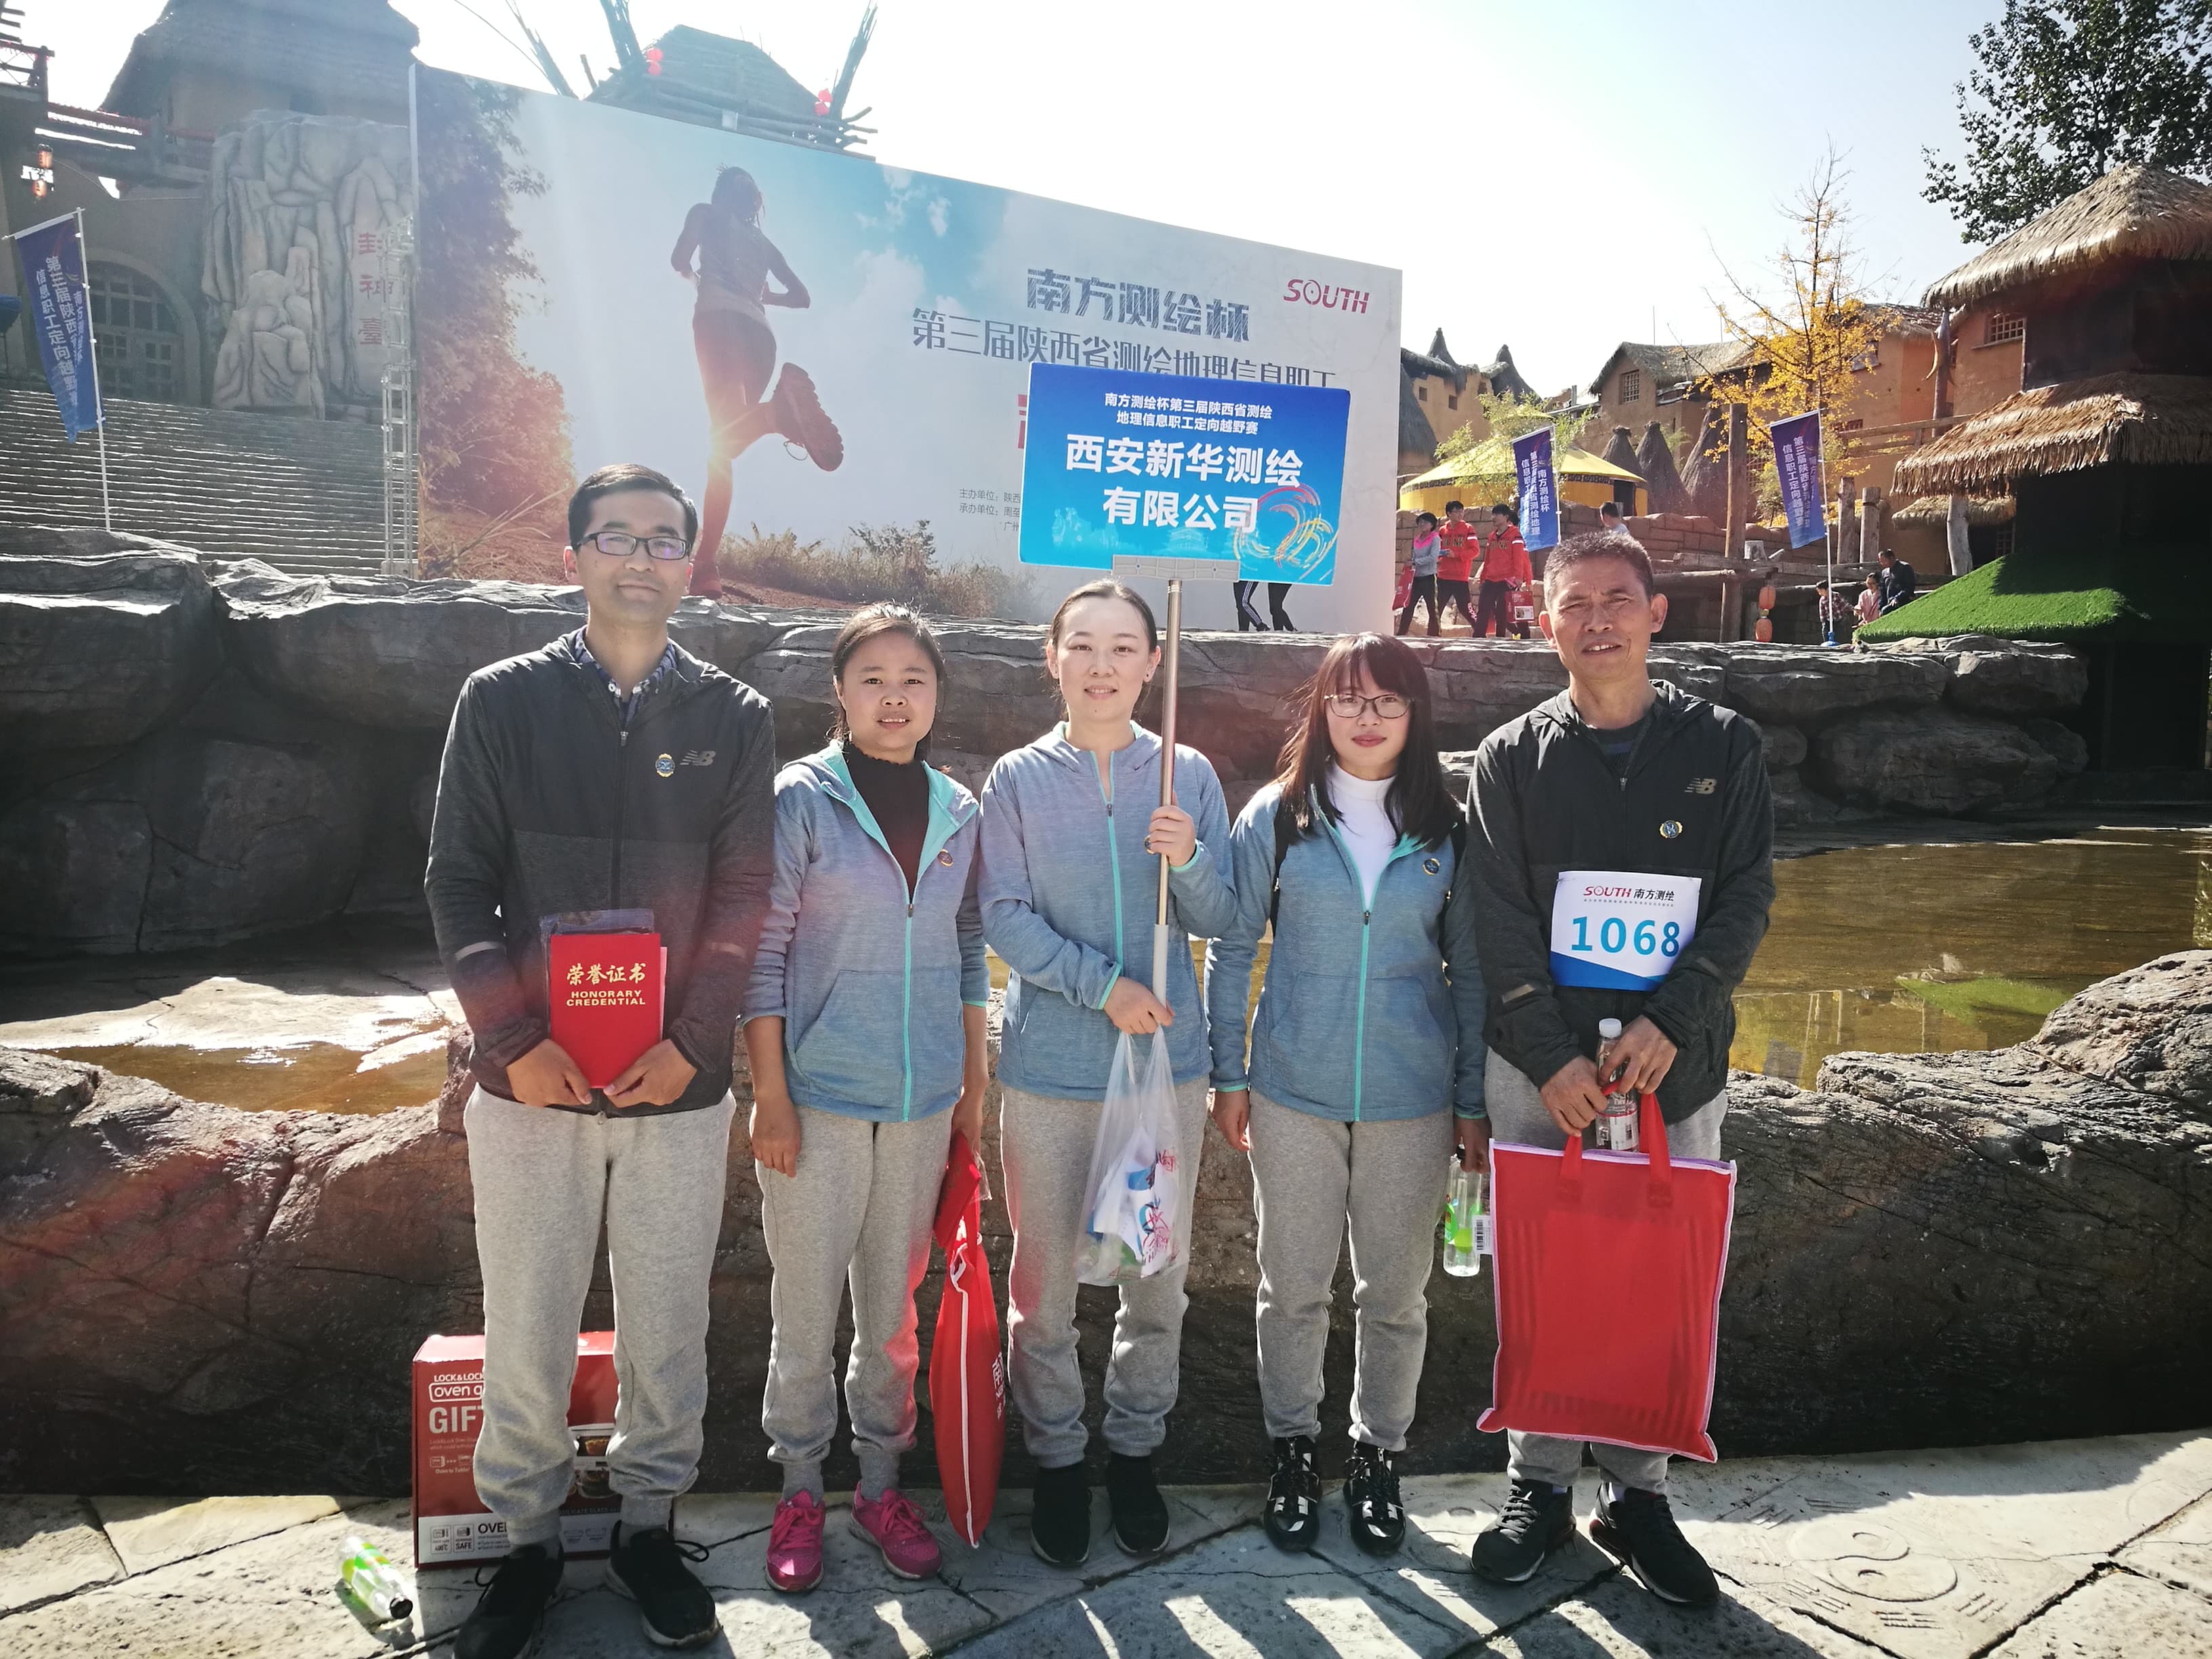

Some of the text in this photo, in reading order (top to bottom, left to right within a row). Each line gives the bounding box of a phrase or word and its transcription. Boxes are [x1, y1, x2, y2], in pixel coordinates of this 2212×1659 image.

[1027, 268, 1250, 343] 南方测绘杯
[1284, 279, 1370, 314] SOUTH
[1105, 392, 1273, 419] 南方测绘杯第三届陕西省测绘
[1116, 411, 1258, 435] 地理信息职工定向越野赛
[1066, 434, 1303, 488] 西安新华测绘
[1103, 486, 1259, 534] 有限公司
[1583, 885, 1675, 901] SOUTH 南方测绘
[1570, 916, 1681, 957] 1068
[567, 962, 646, 985] 荣誉证书
[566, 998, 646, 1006] CREDENTIAL
[571, 989, 642, 999] HONORARY
[434, 1385, 470, 1397] oven
[455, 1542, 472, 1550] SAFE
